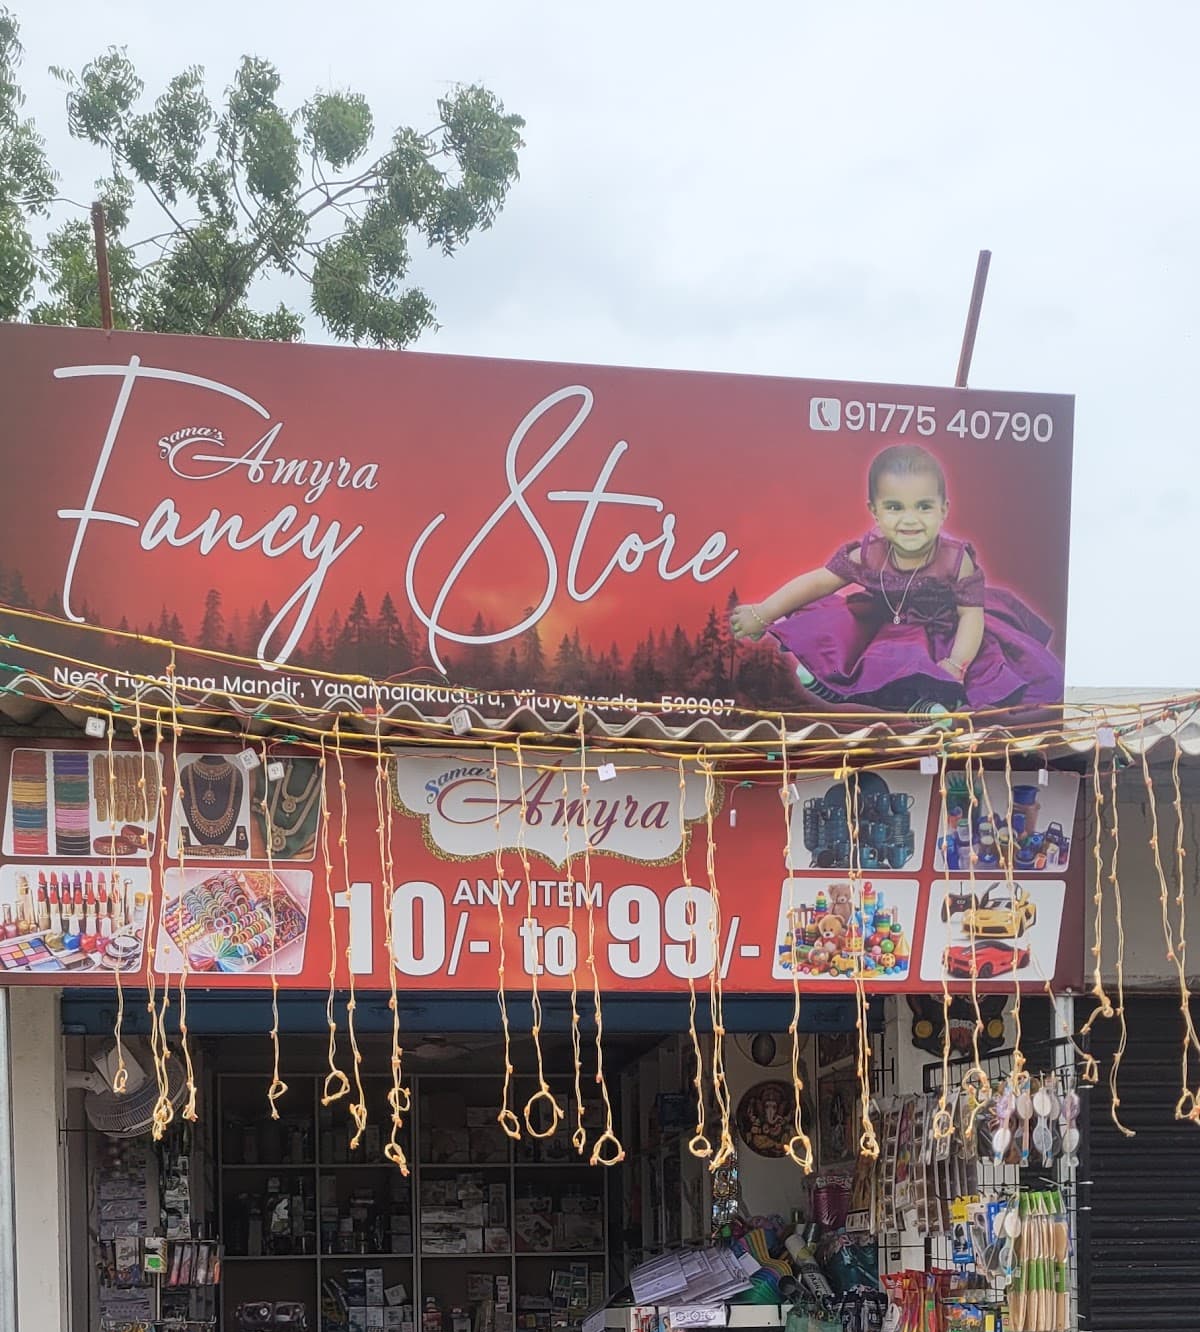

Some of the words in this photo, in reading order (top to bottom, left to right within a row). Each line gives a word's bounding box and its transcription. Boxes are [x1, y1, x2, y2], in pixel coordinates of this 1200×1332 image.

[157, 426, 225, 460] Sama's
[846, 400, 936, 436] 91775
[946, 410, 1054, 442] 40790
[168, 422, 379, 504] Amyra
[53, 355, 364, 671] Fancy
[405, 384, 739, 675] Store
[223, 675, 304, 698] Mandir,
[661, 695, 736, 716] 520007
[437, 758, 670, 844] Amyra
[452, 879, 521, 906] ANY
[530, 880, 603, 907] ITEM
[335, 881, 491, 977] 10/-
[520, 917, 577, 977] to
[607, 884, 761, 980] 99/-
